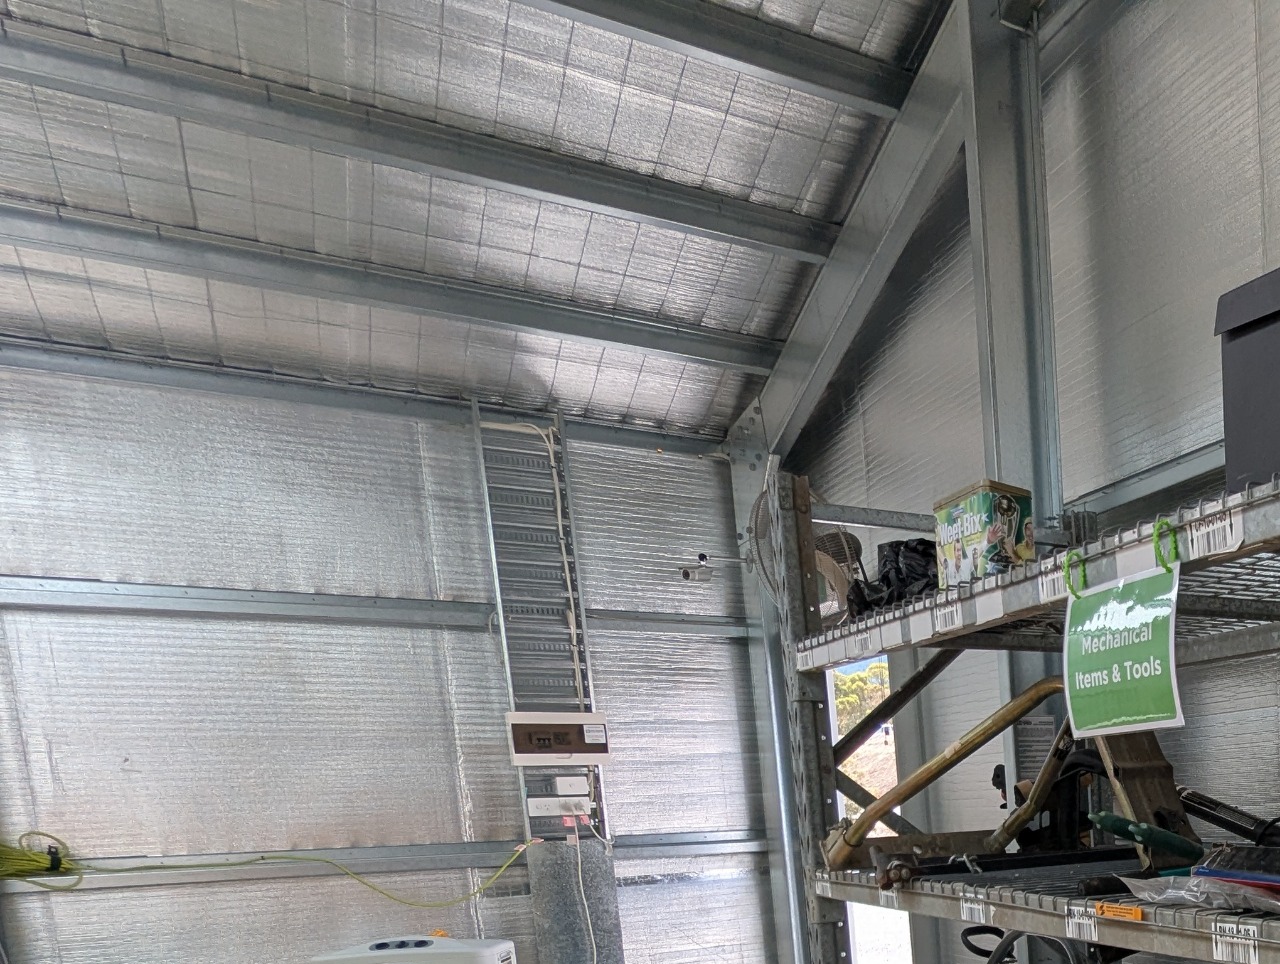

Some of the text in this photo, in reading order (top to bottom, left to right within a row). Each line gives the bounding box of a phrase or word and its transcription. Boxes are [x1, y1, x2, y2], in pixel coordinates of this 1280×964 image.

[940, 512, 982, 546] Weet-Bix
[1082, 622, 1152, 655] Mechanical
[1075, 656, 1162, 690] Items & Tools
